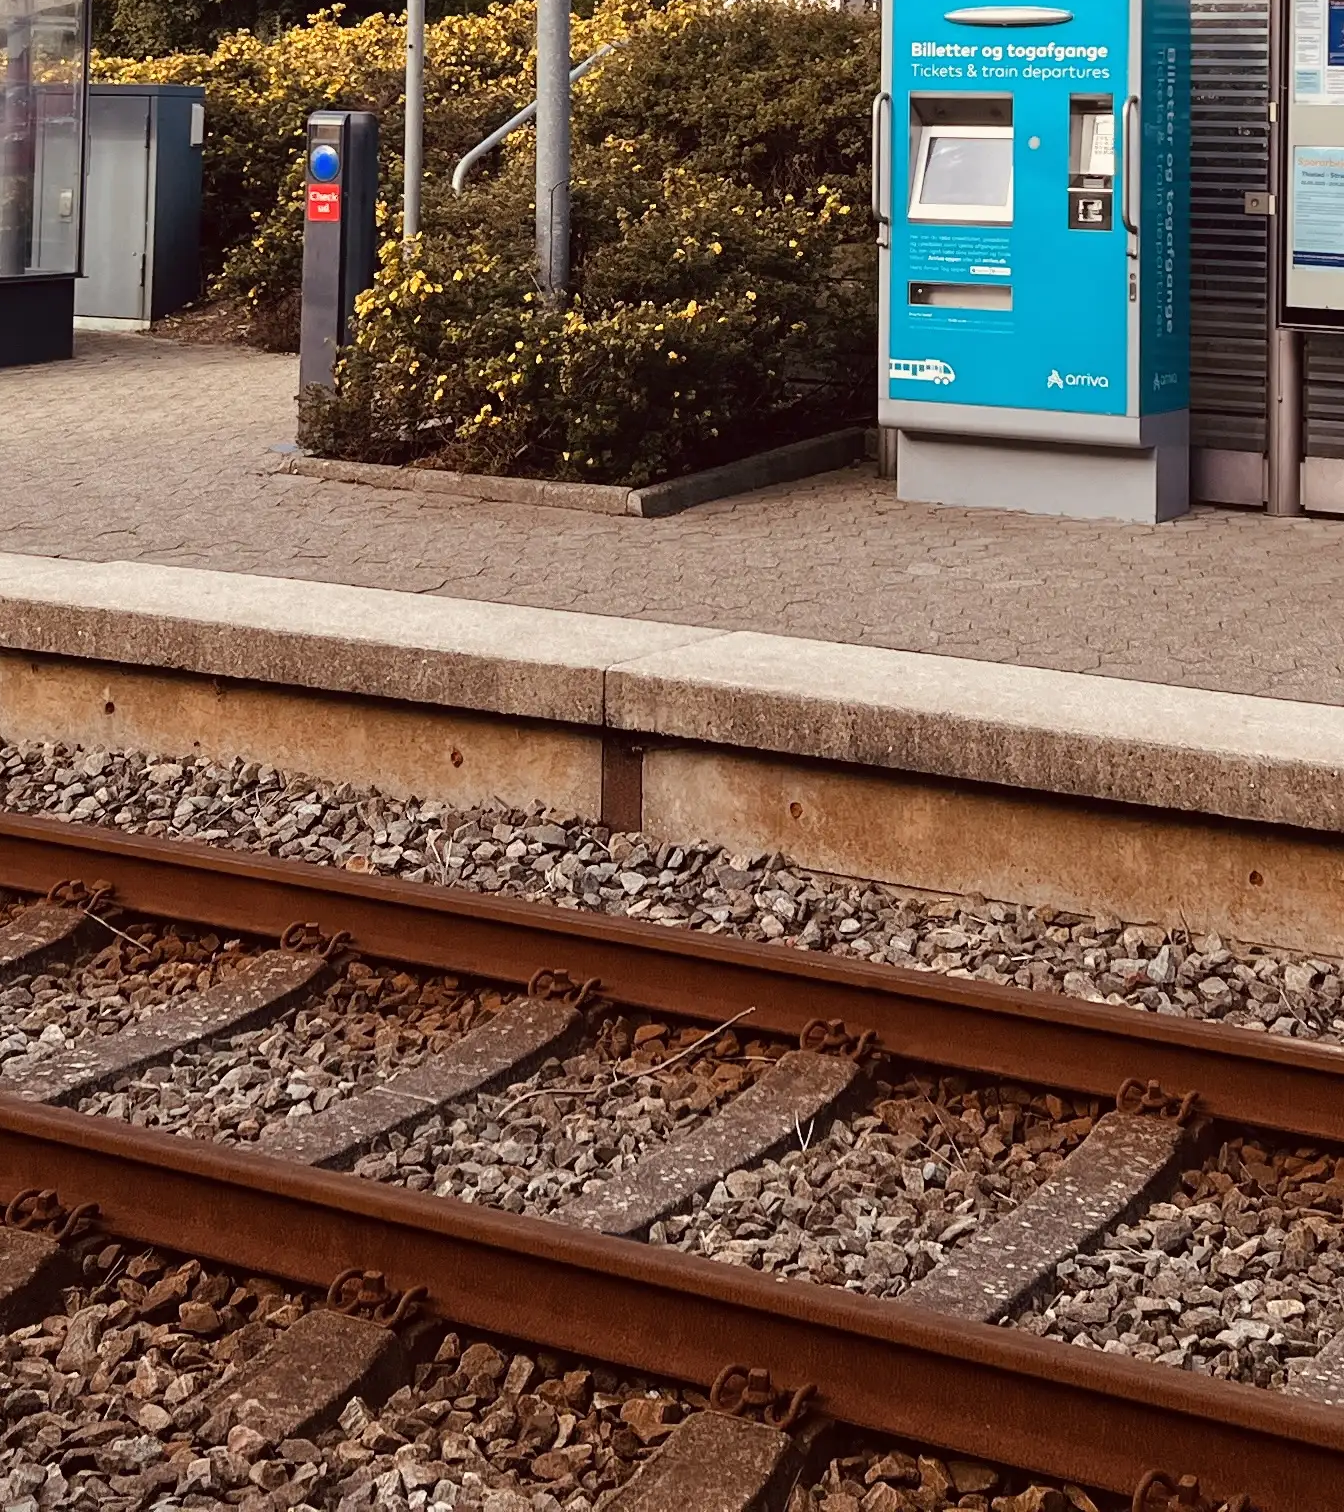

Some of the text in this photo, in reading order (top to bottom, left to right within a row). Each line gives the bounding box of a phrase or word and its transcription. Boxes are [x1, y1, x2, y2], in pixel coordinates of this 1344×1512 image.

[911, 42, 1109, 62] Billetter og togafgange
[911, 63, 1110, 81] Tickets & train departures
[310, 191, 339, 202] Check
[1065, 372, 1109, 388] arriva
